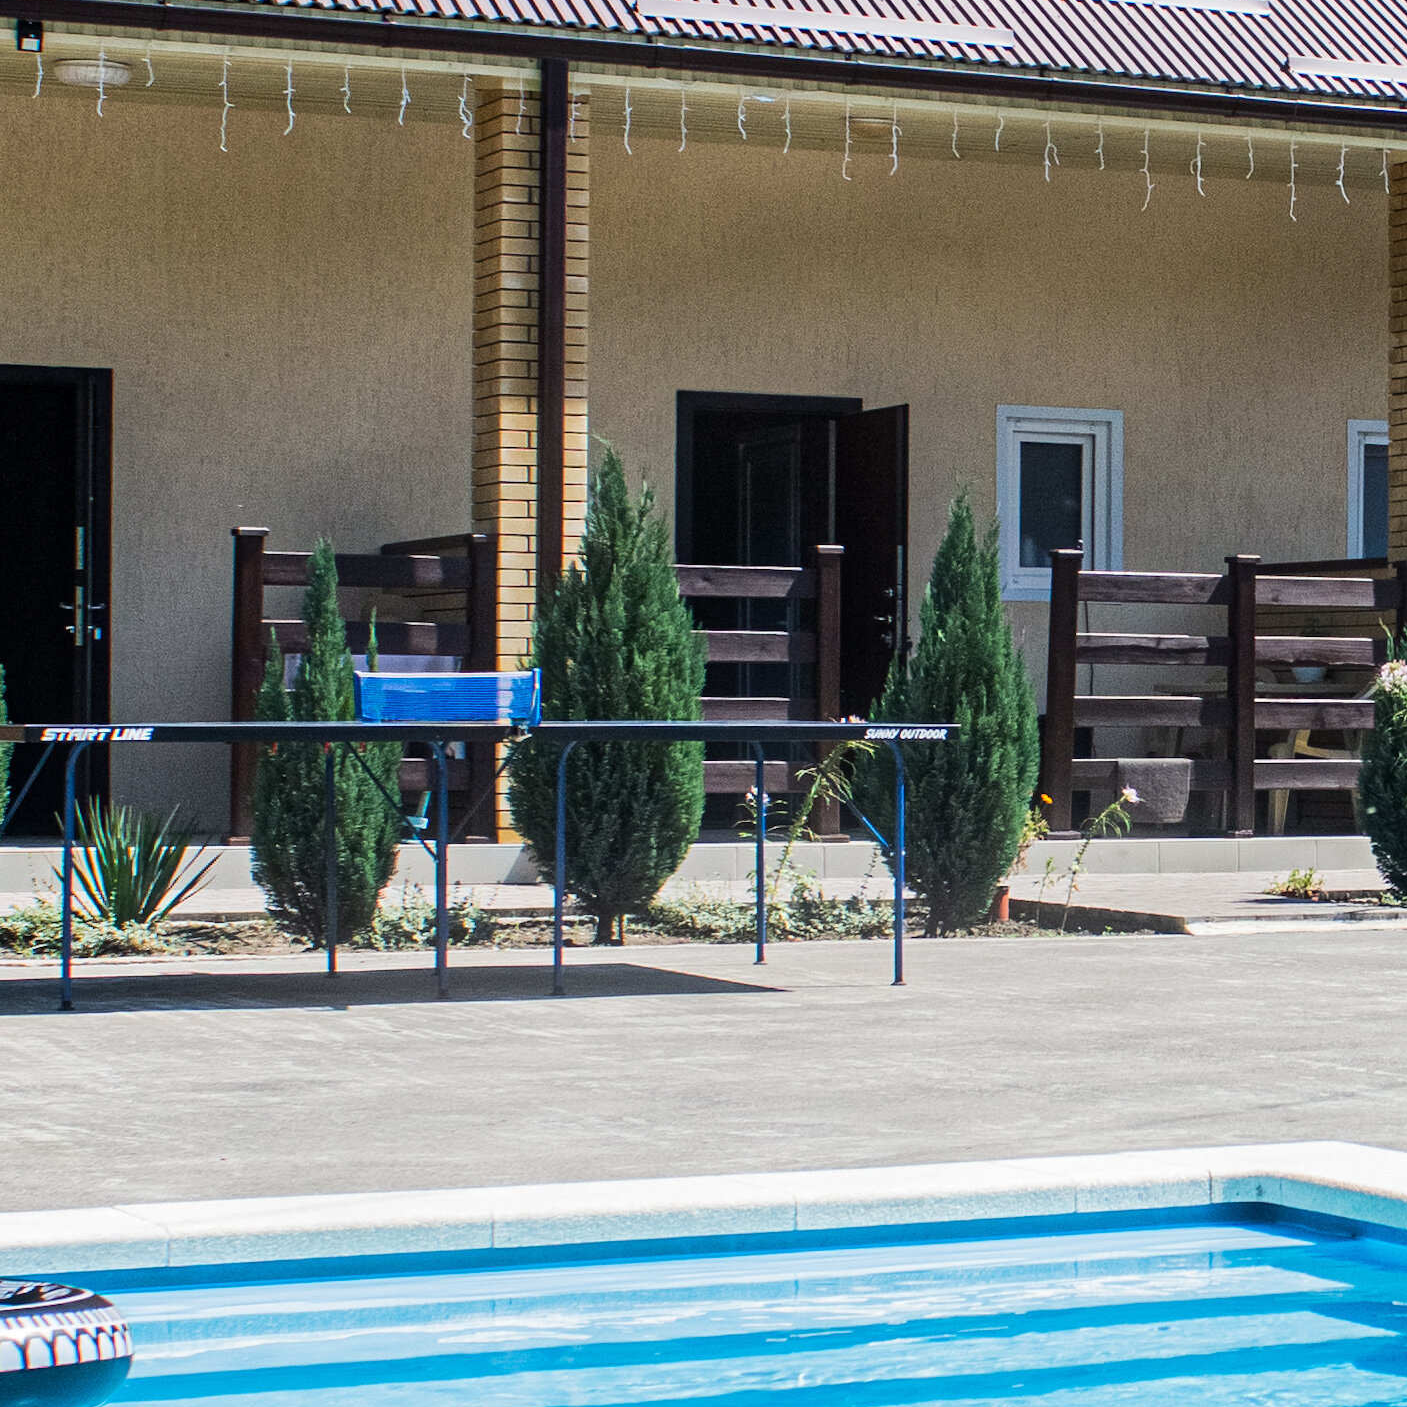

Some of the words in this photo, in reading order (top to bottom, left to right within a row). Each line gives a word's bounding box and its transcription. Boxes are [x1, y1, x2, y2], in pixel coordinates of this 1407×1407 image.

[40, 728, 112, 741] START
[111, 728, 154, 741] LINE
[864, 728, 900, 740] SUNNY
[899, 728, 948, 740] OUTDOOR
